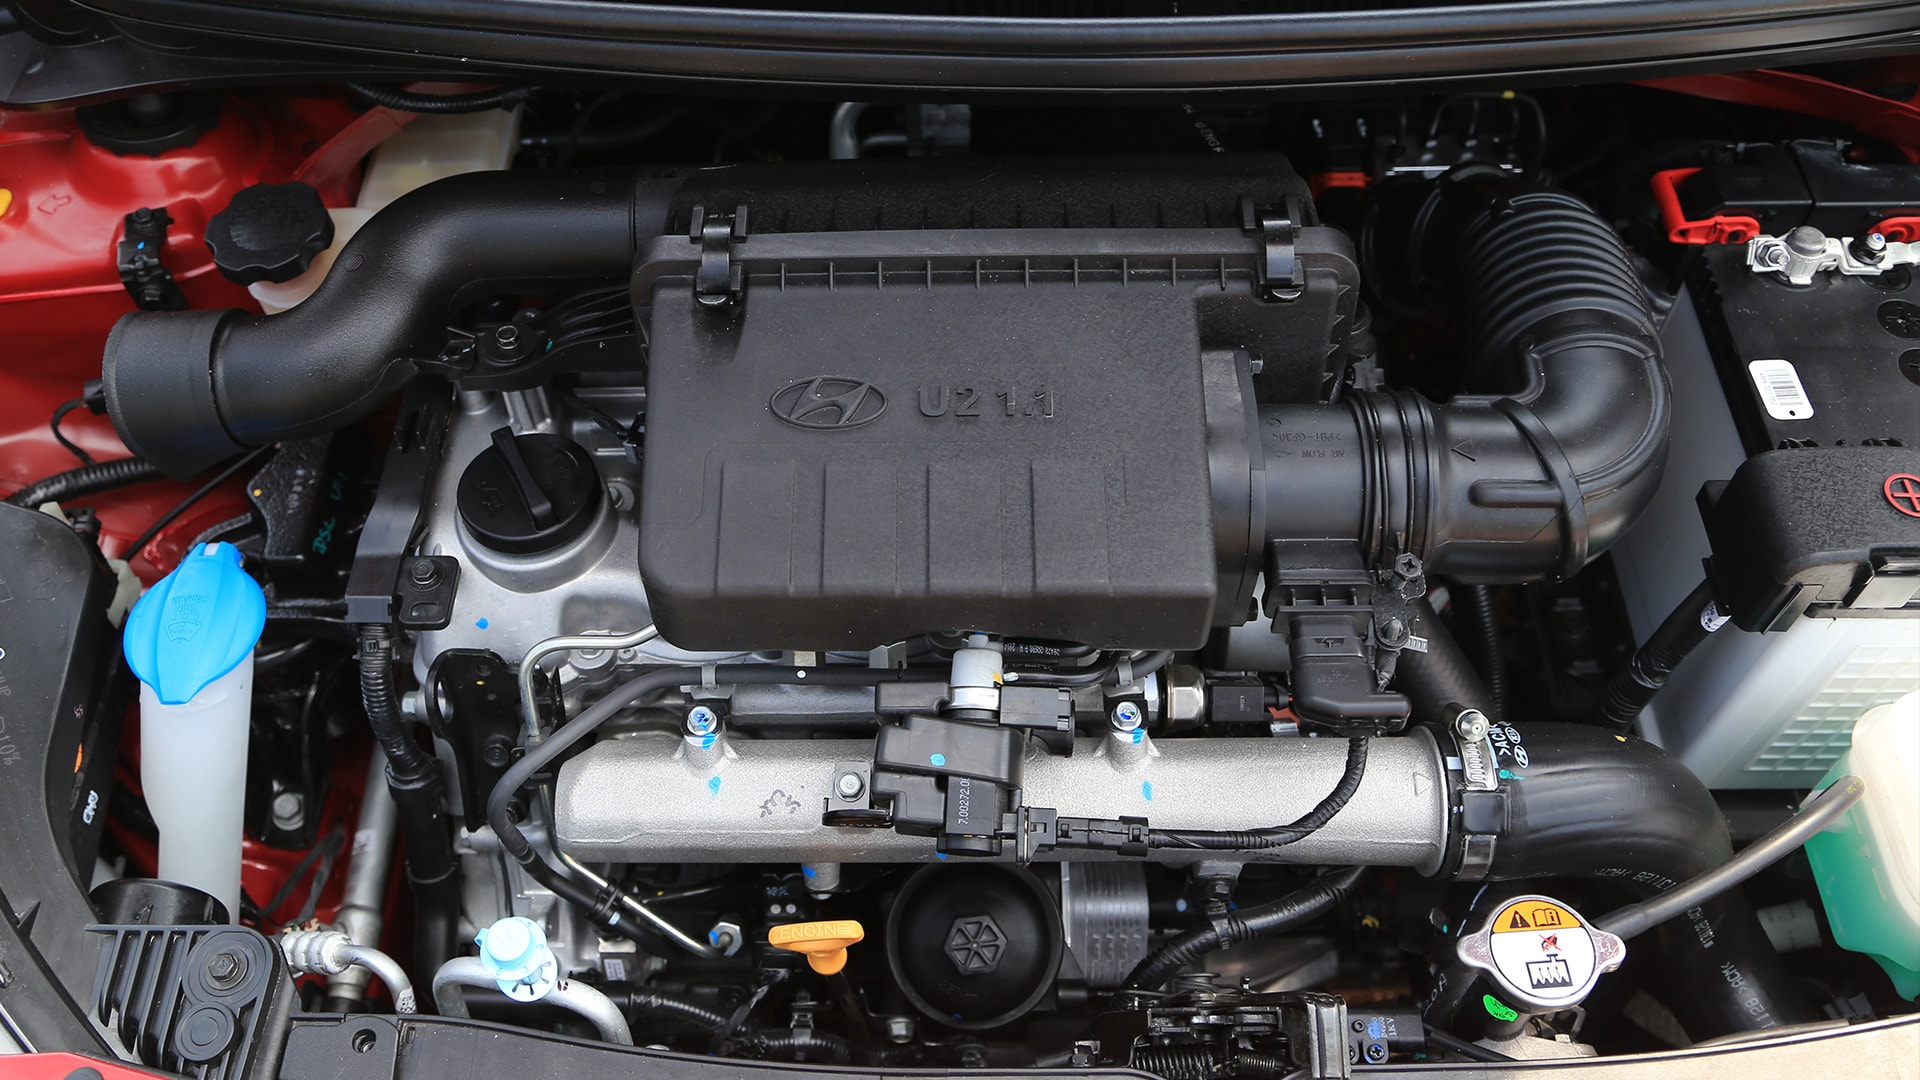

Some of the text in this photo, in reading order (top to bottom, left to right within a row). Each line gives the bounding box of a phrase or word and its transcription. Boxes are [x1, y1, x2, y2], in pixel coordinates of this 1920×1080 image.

[918, 384, 1055, 418] U2 1.1
[1301, 449, 1326, 458] FLOW
[780, 922, 851, 940] ENGINE
